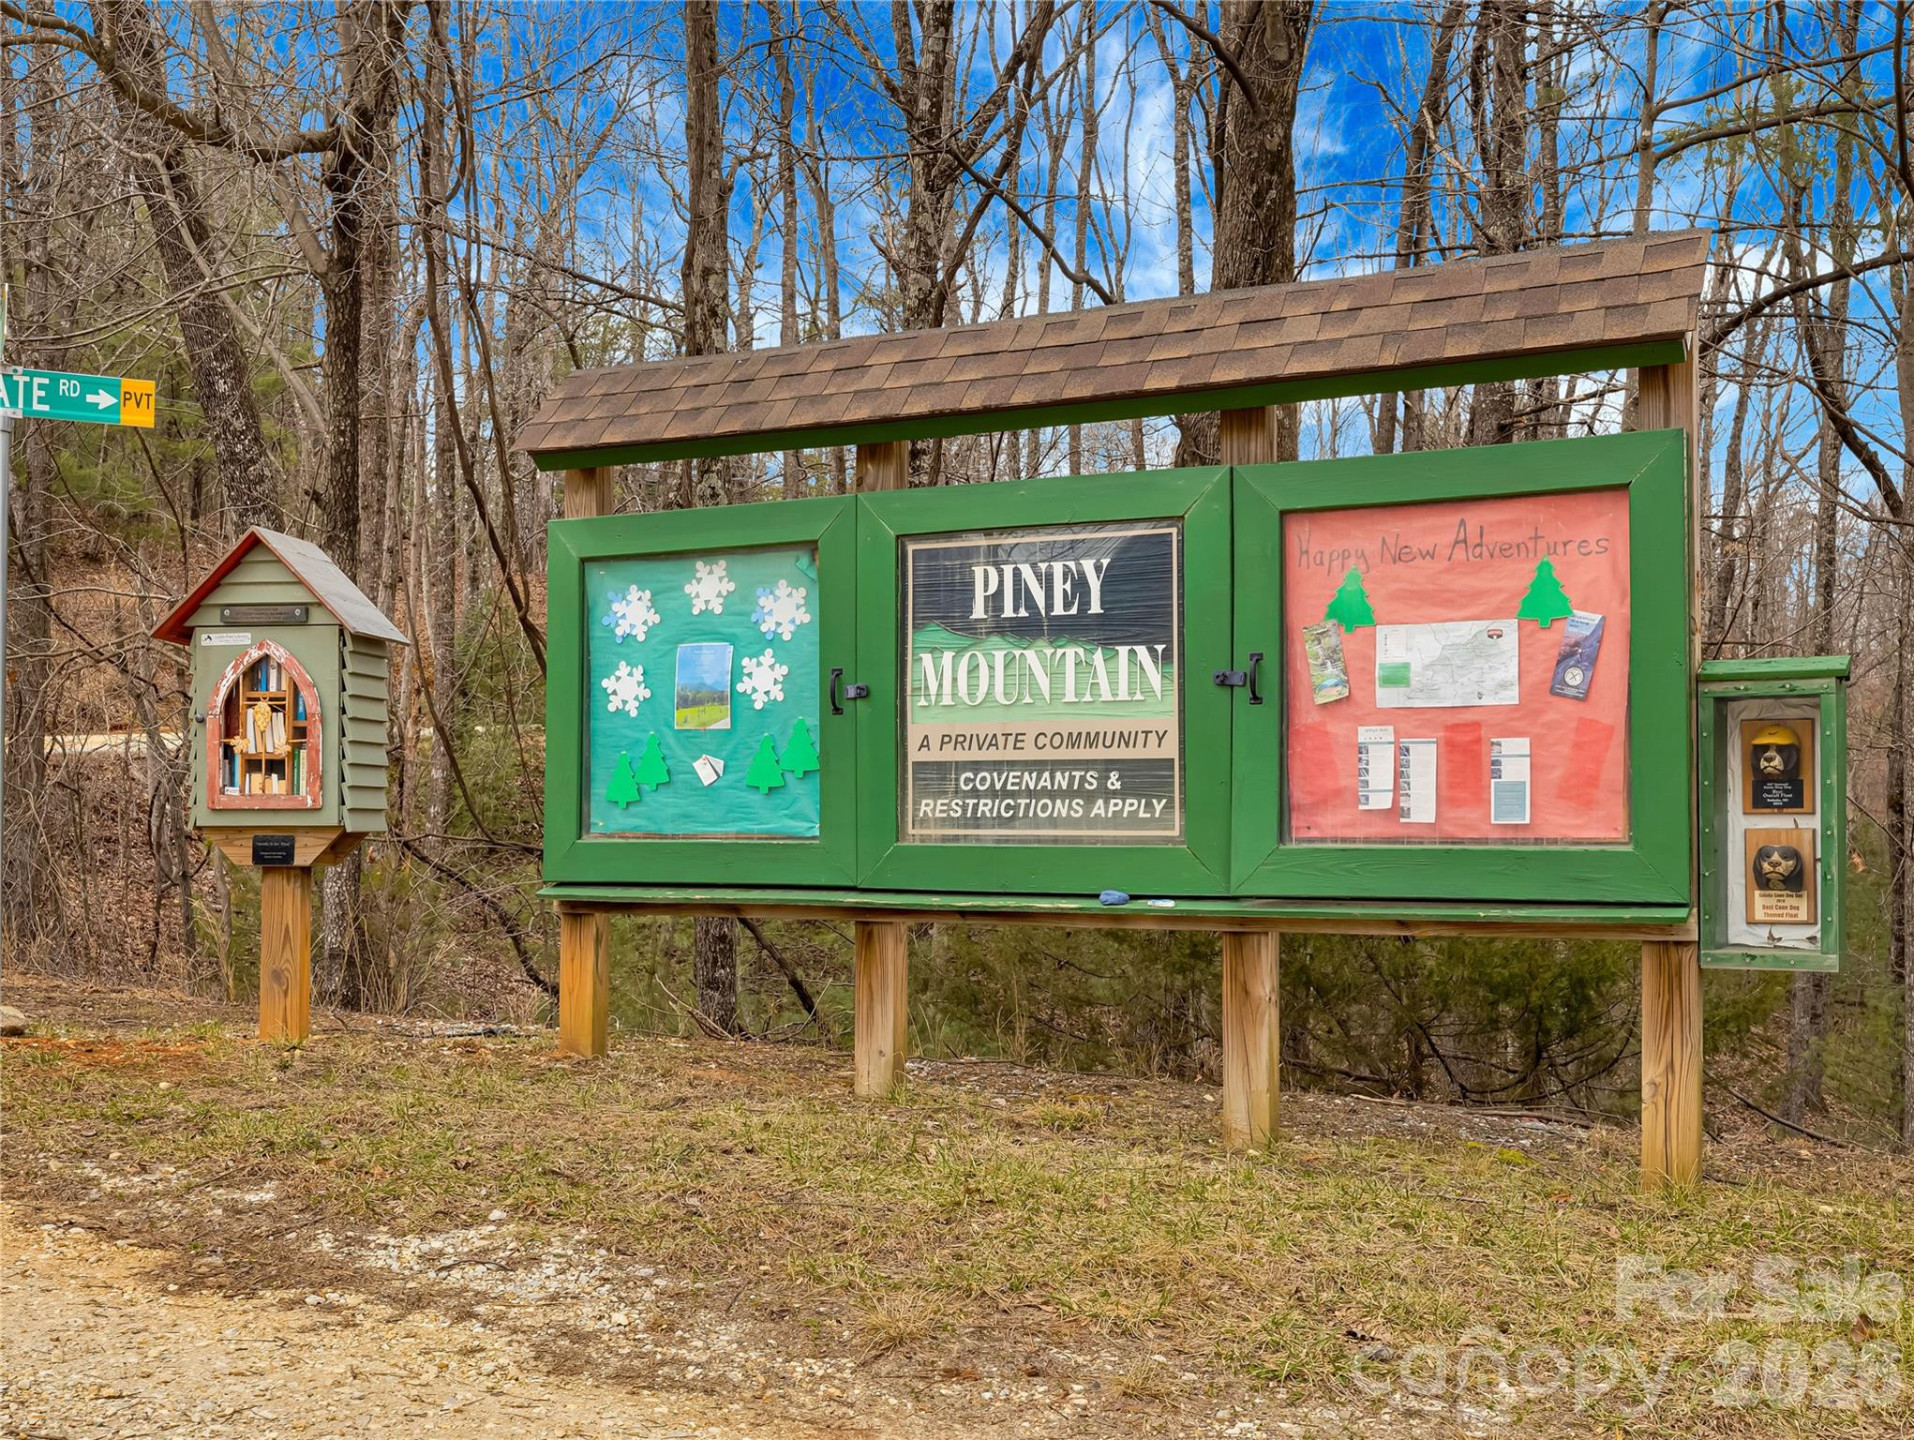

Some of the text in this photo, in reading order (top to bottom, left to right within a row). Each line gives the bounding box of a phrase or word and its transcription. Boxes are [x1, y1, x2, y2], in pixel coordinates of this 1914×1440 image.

[59, 379, 81, 397] RD
[123, 391, 153, 410] PVT
[1297, 517, 1611, 577] Happy New Adventures
[969, 558, 1111, 620] PINEY
[917, 644, 1168, 708] MOUNTAIN
[917, 729, 1169, 752] A PRIVATE COMMUNITY
[959, 770, 1122, 791] COVENANTS &
[919, 798, 1168, 819] RESTRICTIONS APPLY
